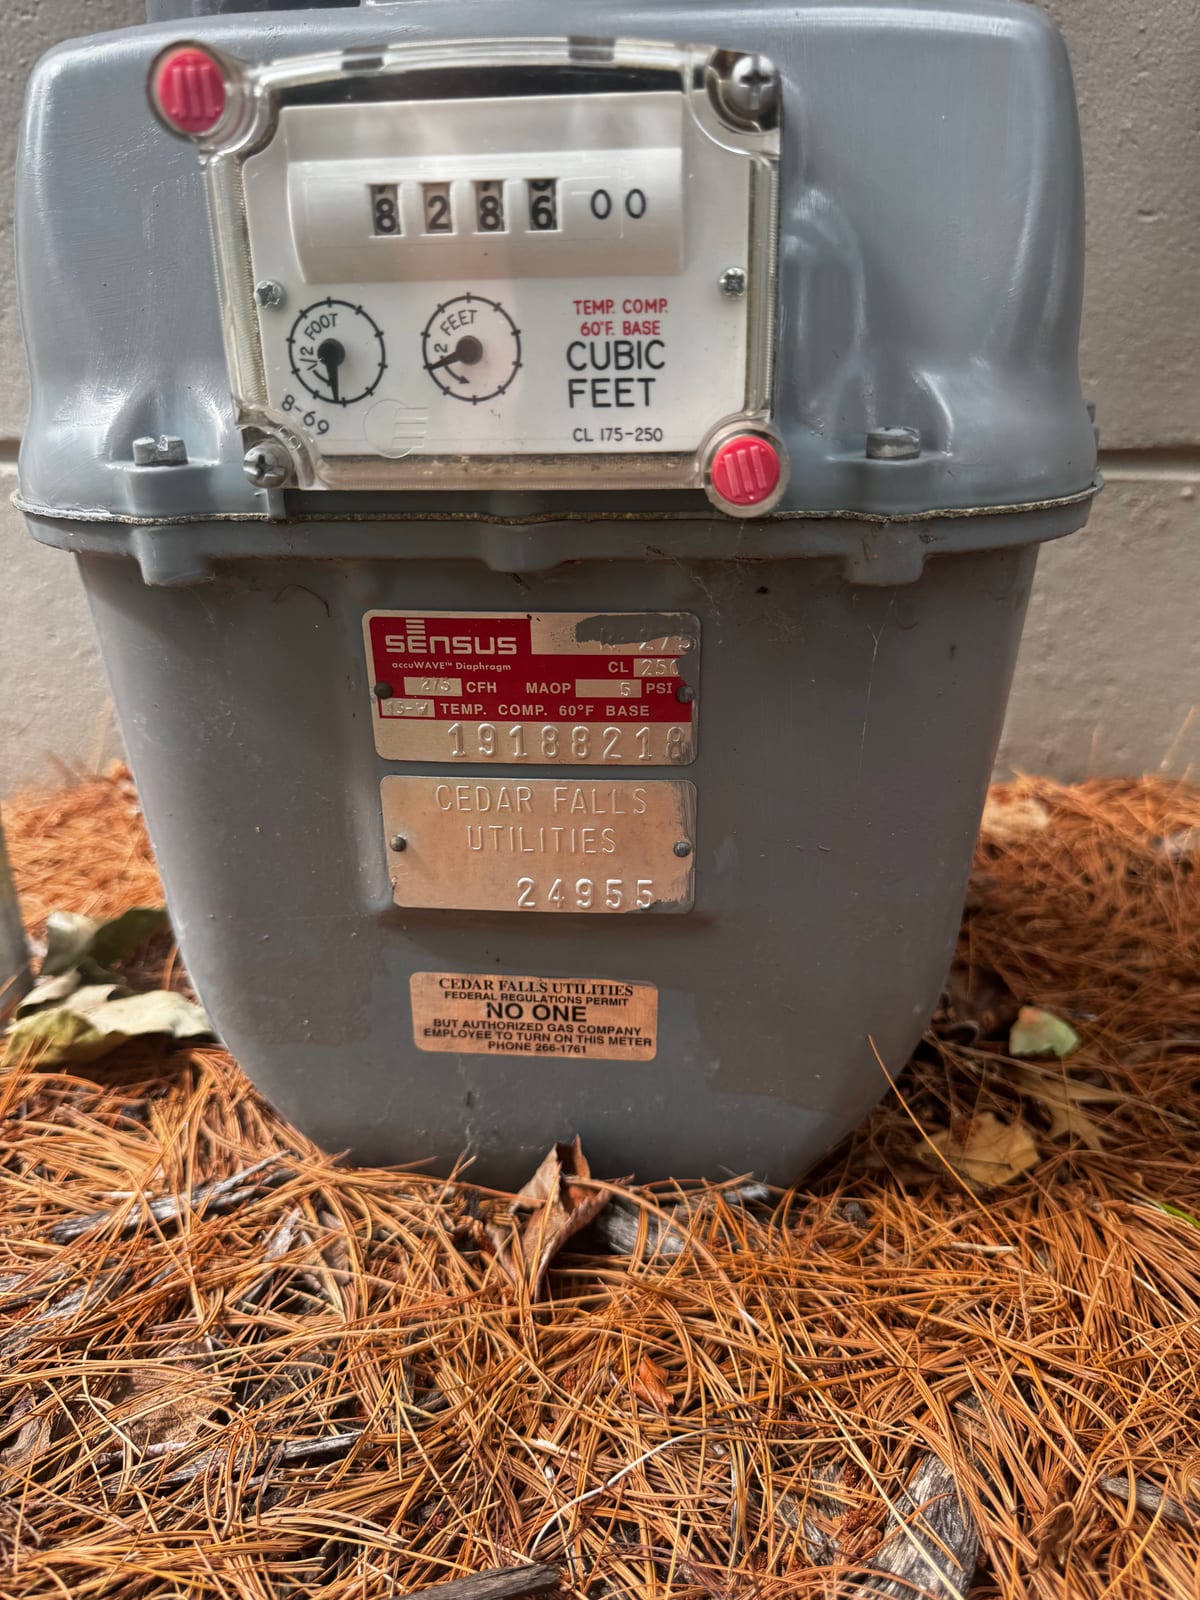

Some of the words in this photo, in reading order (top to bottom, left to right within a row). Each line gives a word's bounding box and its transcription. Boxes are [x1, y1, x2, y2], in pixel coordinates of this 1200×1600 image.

[573, 300, 615, 315] TEMP.
[622, 298, 668, 314] COMP.
[304, 313, 339, 341] FOOT
[439, 309, 478, 336] FEET
[622, 320, 661, 335] BASE
[434, 343, 448, 353] 2
[566, 340, 665, 371] CUBIC
[568, 378, 656, 408] FEET
[281, 394, 330, 435] 8-69
[573, 428, 594, 442] CL
[600, 427, 663, 442] 175-250
[455, 662, 512, 672] Diaphragm
[608, 661, 629, 673] CL
[466, 681, 497, 693] CFH
[526, 683, 572, 694] MAOP
[645, 682, 673, 694] PSI
[440, 703, 487, 715] TEMP.
[498, 704, 548, 716] COMP.
[559, 704, 595, 716] 60°F
[605, 704, 650, 717] BASE
[447, 722, 686, 760] 19188218
[435, 785, 533, 813] CEDAR
[553, 786, 649, 815] FALLS
[467, 825, 617, 854] UTILITIES
[516, 876, 654, 909] 24955
[439, 977, 493, 990] CEDAR
[499, 981, 548, 993] FALLS
[552, 983, 634, 997] UTILITIES
[444, 991, 497, 1001] FEDERAL
[500, 993, 582, 1005] REGULATIONS
[585, 998, 629, 1007] PERMIT
[486, 1002, 523, 1019] NO
[532, 1004, 587, 1022] ONE
[433, 1018, 458, 1028] BUT
[462, 1020, 544, 1031] AUTHORIZED
[547, 1024, 574, 1033] GAS
[578, 1025, 641, 1036] COMPANY
[423, 1028, 493, 1039] EMPLOYEE
[499, 1032, 513, 1040] TO
[516, 1033, 550, 1042] TURN
[554, 1034, 572, 1043] ON
[575, 1035, 604, 1045] THIS
[608, 1037, 652, 1047] METER
[488, 1041, 532, 1051] PHONE
[535, 1043, 587, 1053] 266-1761
